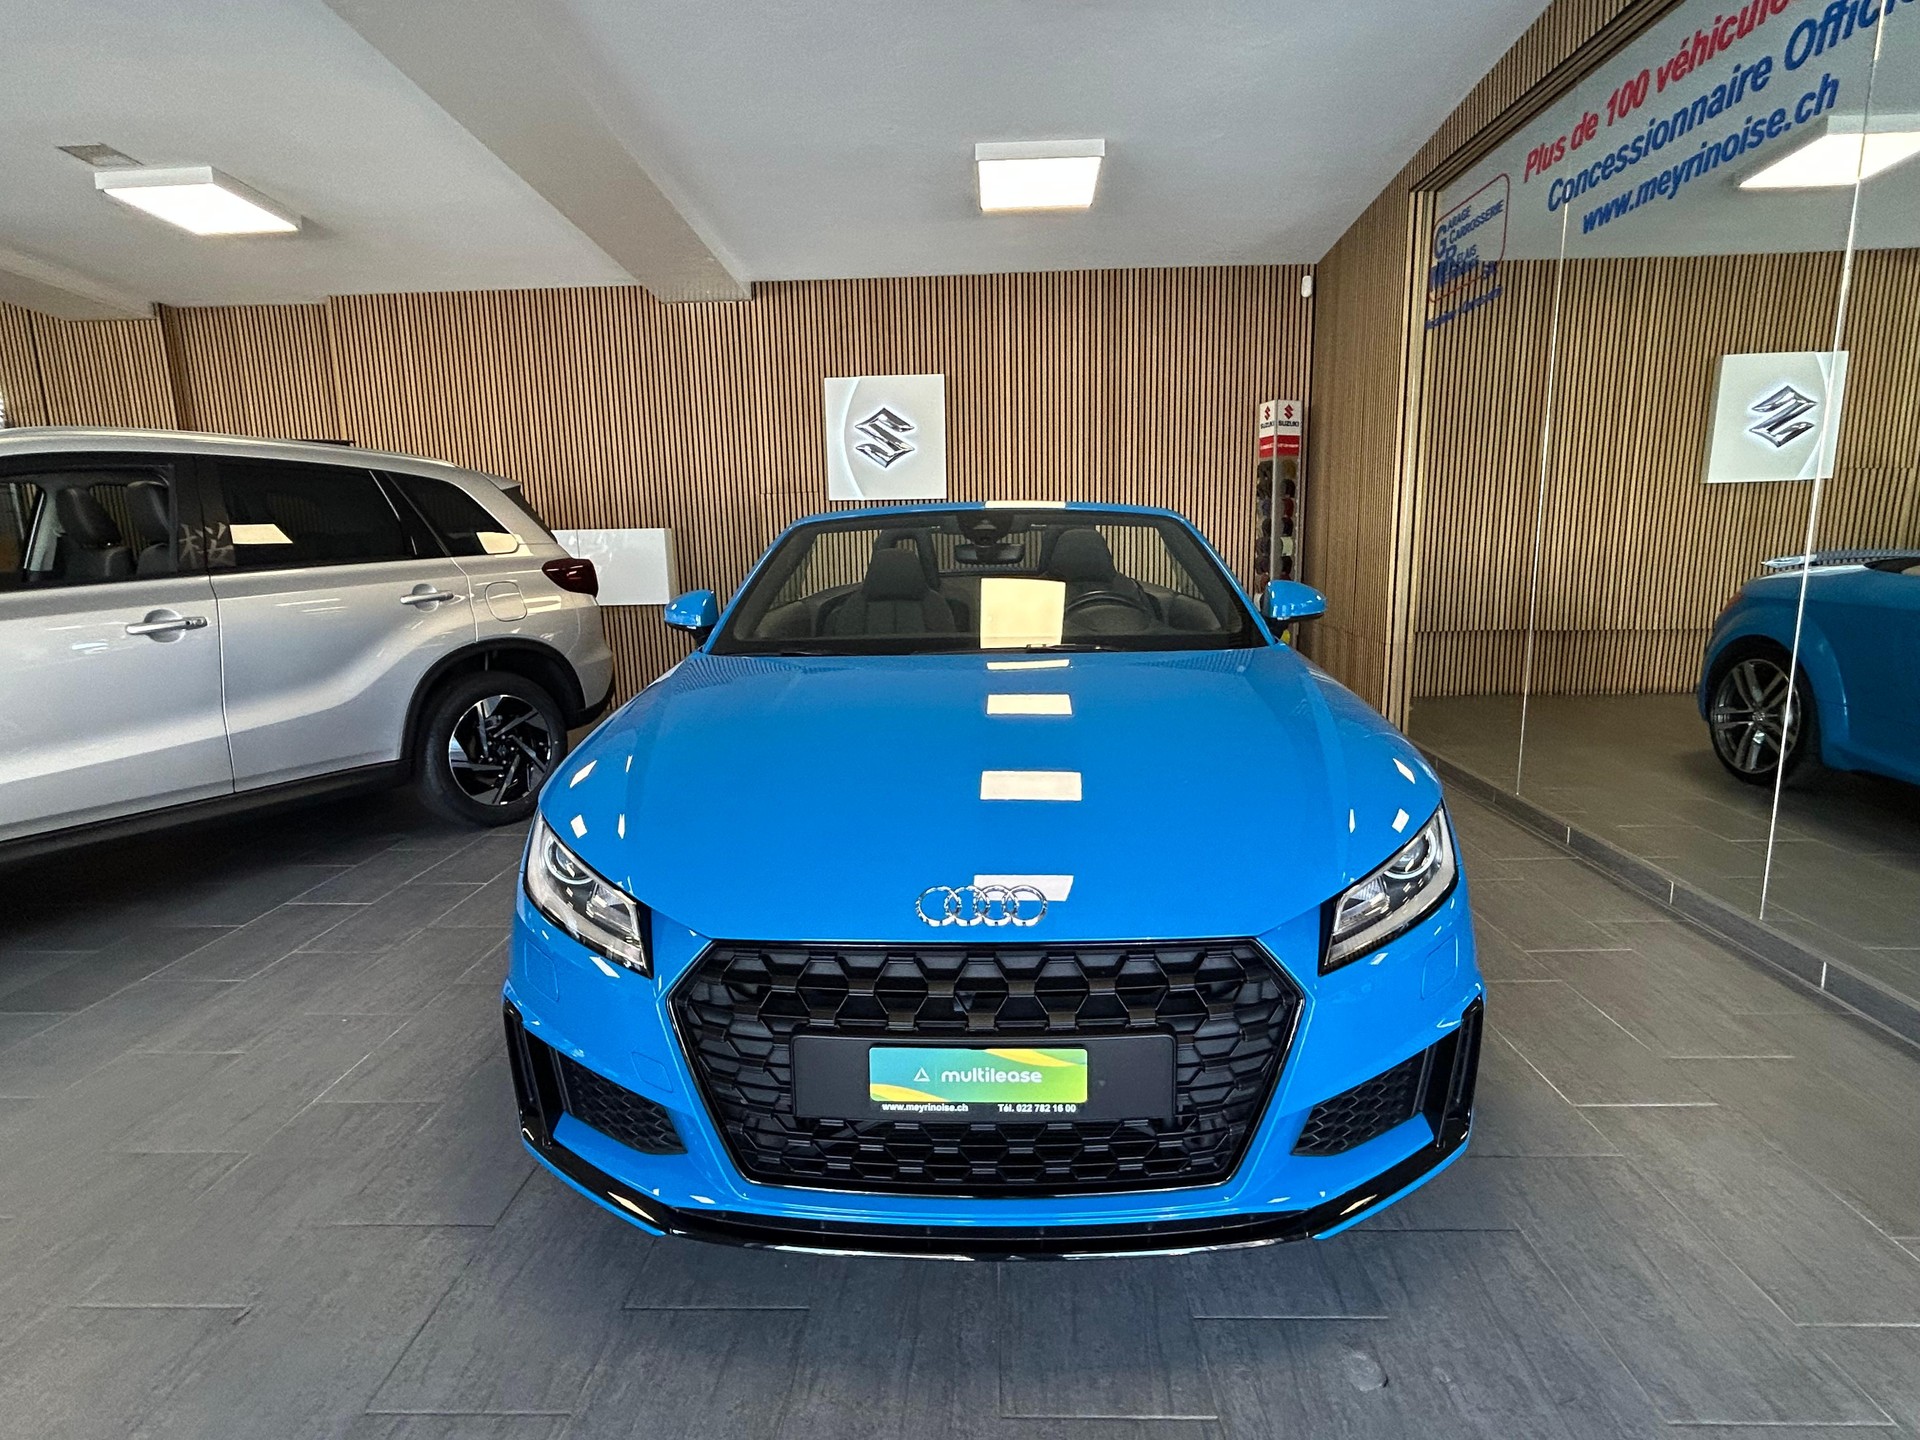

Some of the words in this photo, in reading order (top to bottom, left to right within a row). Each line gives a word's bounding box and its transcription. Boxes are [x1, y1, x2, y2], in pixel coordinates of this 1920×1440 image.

[1524, 136, 1567, 183] Plus
[1571, 112, 1599, 151] de
[1607, 69, 1650, 127] 100
[1548, 55, 1773, 211] Concessionnaire
[1784, 0, 1914, 71] Offic
[1583, 73, 1840, 234] www.meyrinoise.ch
[941, 1067, 1042, 1083] multilease
[998, 1103, 1014, 1112] Tél.
[1016, 1103, 1033, 1112] 022
[1034, 1103, 1051, 1112] 782
[1053, 1103, 1063, 1112] 16
[1065, 1103, 1077, 1112] 00
[881, 1103, 969, 1113] www.meyrinoise.ch
